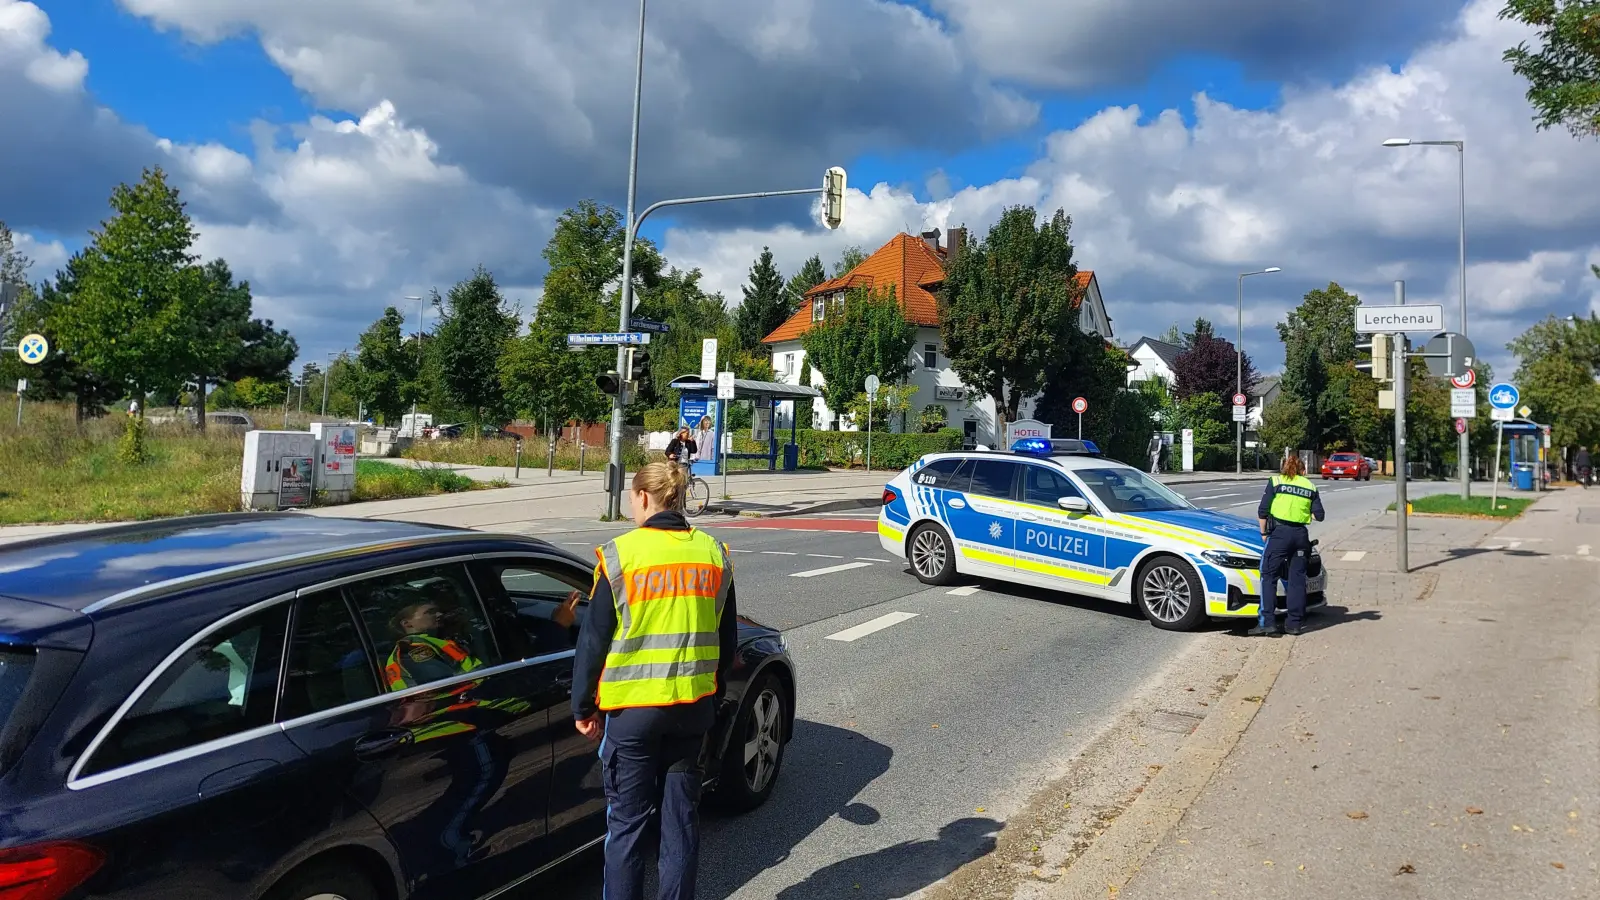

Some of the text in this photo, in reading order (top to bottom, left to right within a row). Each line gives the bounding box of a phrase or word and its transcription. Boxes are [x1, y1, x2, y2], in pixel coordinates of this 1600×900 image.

[1364, 313, 1434, 325] Lerchenau
[1014, 429, 1043, 437] HOTEL
[924, 475, 937, 485] 110
[1281, 485, 1312, 497] POLIZEI
[1026, 528, 1089, 557] POLIZEI
[633, 567, 716, 596] POLIZEI
